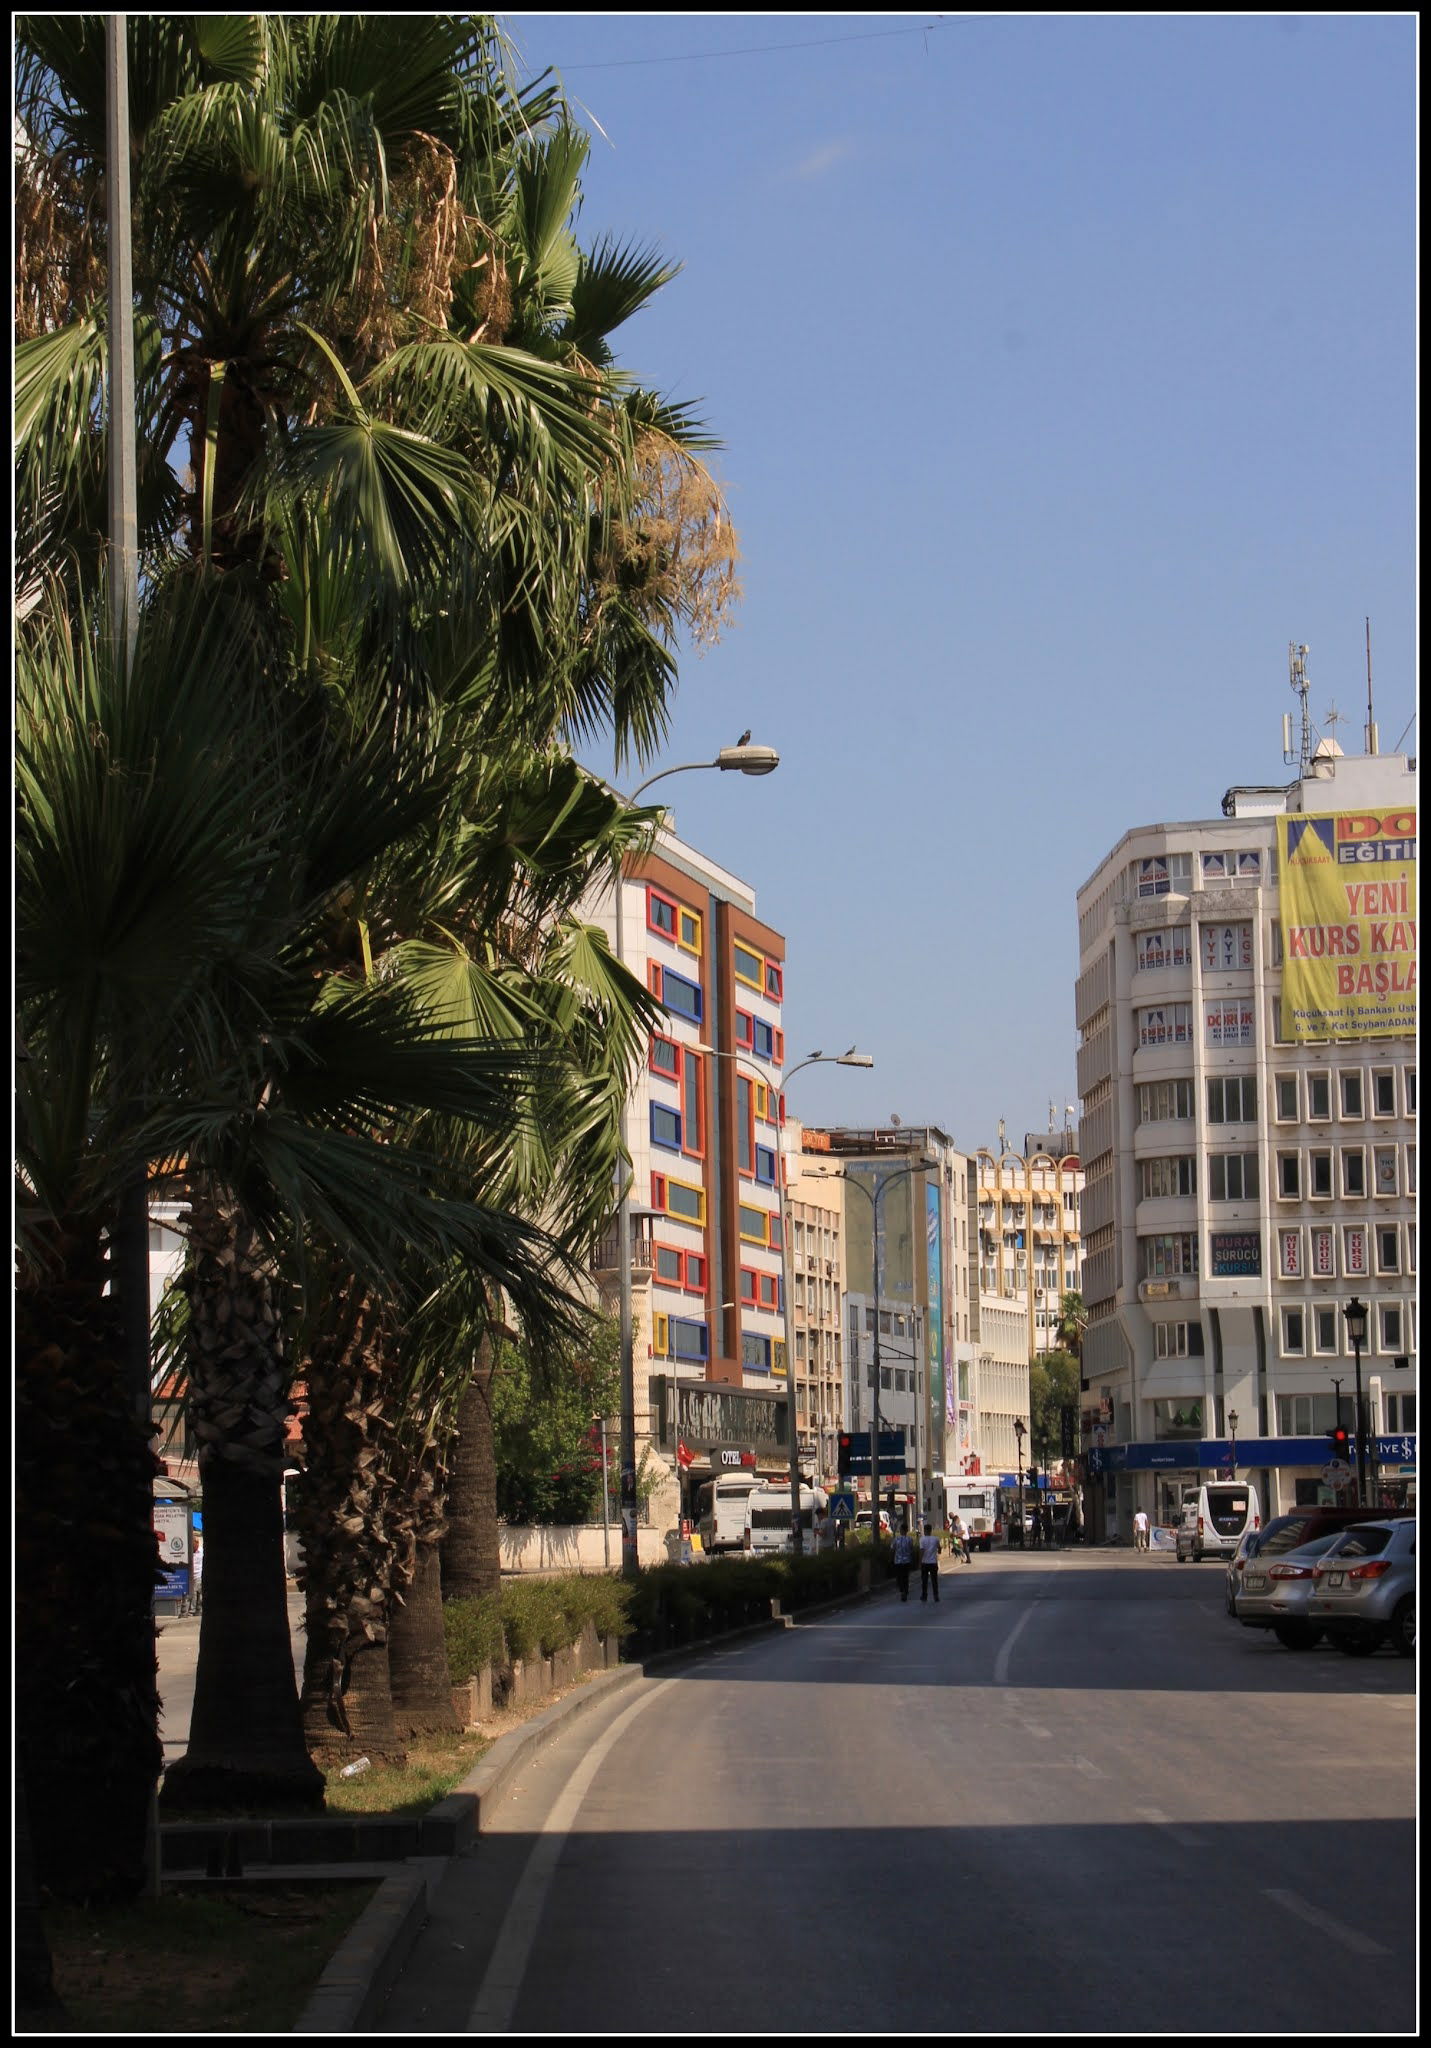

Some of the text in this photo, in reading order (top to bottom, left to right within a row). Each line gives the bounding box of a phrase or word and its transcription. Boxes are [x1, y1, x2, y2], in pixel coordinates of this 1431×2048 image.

[1338, 812, 1416, 840] DO
[1340, 840, 1416, 863] EĞİTİ
[1345, 872, 1408, 917] YENİ
[1289, 924, 1360, 958] KURS
[1216, 1236, 1257, 1248] MURAT
[1286, 1235, 1297, 1272] MURAT
[1352, 1233, 1362, 1269] KURSU
[721, 1450, 741, 1464] OTEL
